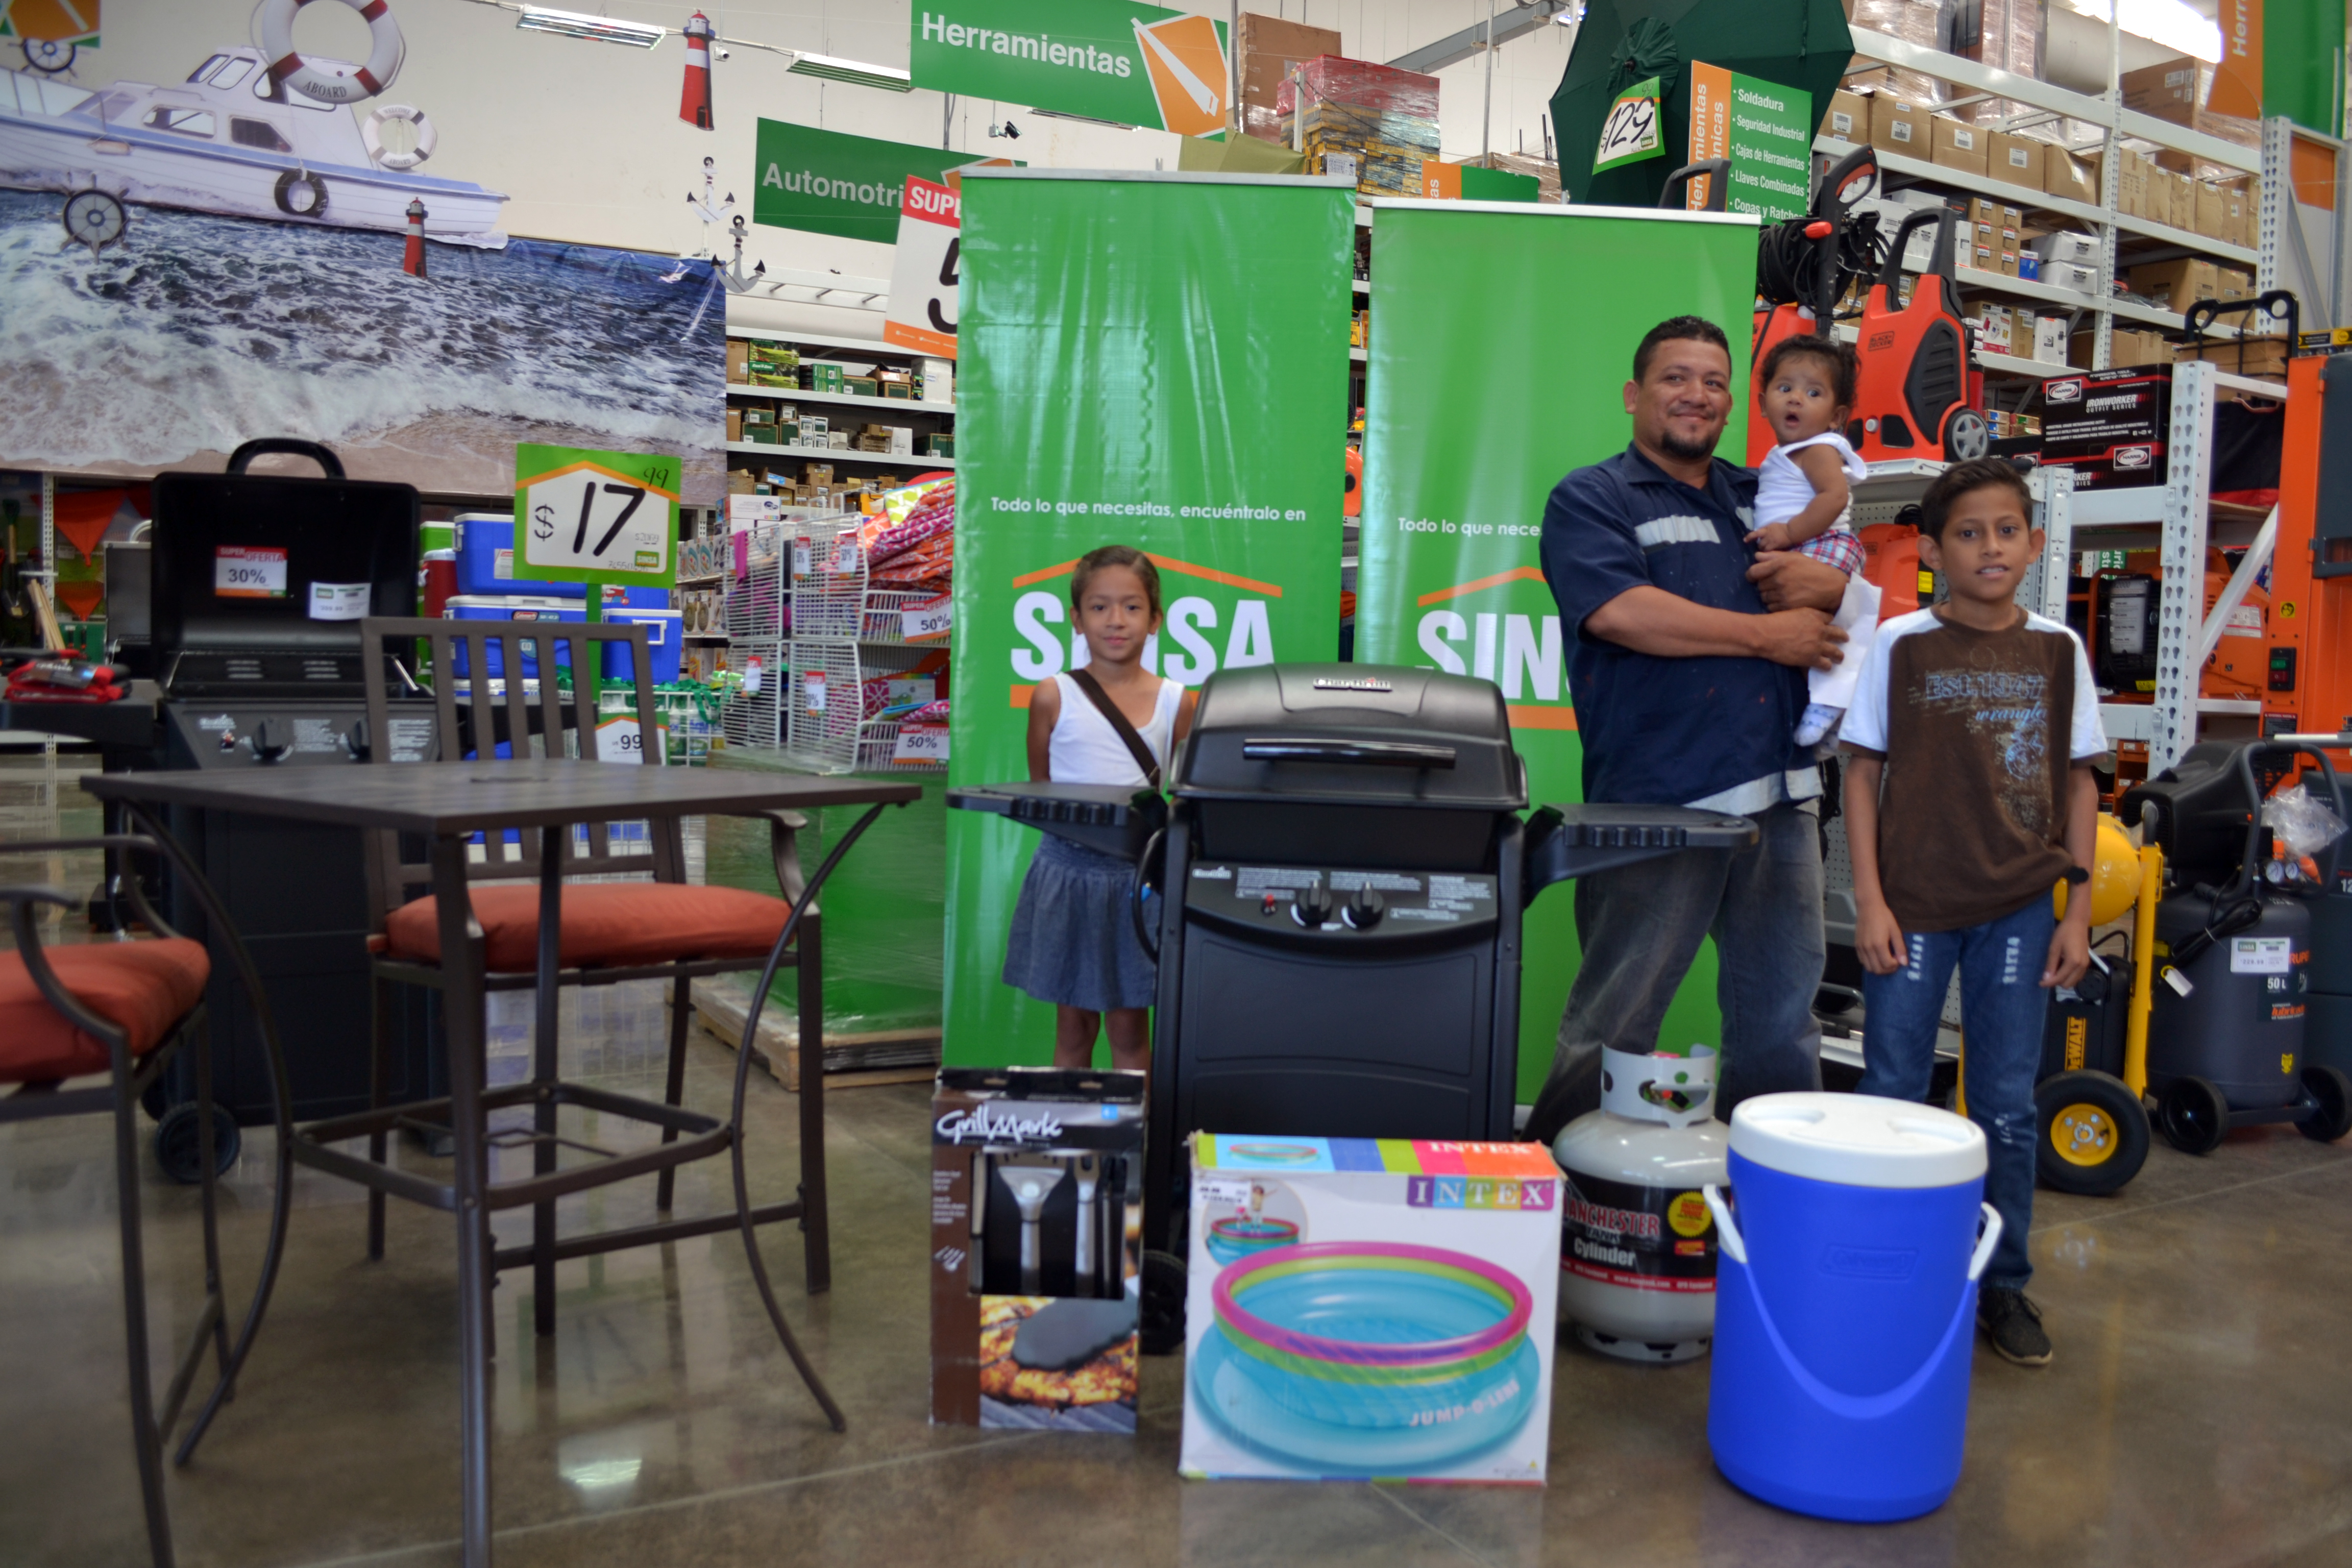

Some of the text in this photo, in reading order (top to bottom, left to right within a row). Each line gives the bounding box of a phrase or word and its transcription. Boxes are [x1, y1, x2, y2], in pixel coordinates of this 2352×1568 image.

[922, 12, 1131, 78] Herramientas
[303, 80, 347, 98] ABOARD
[1737, 88, 1784, 112] Soldadura
[1736, 114, 1805, 142] Seguridad Industrial
[1690, 83, 1707, 211] Hermientas
[1735, 143, 1805, 171] Cajas de Herramientas
[1735, 169, 1804, 197] Llaves Combinadas
[1734, 198, 1760, 214] Copas
[1762, 207, 1768, 218] y
[2086, 394, 2138, 408] IRONWORKER
[2112, 402, 2137, 411] SERIES
[643, 467, 669, 488] 99
[573, 481, 646, 557] 17
[990, 497, 1306, 521] Todo lo que necesitas, encuéntralo en
[1398, 517, 1542, 539] Todo lo que nece
[220, 547, 246, 555] SUPER
[246, 551, 285, 562] OFERTA
[228, 568, 267, 584] 30%
[920, 613, 951, 631] 50%
[1011, 591, 1275, 687] SSA
[1417, 610, 1571, 701] SIN
[906, 736, 938, 749] 50%
[2267, 977, 2286, 990] 50 L
[1429, 1141, 1536, 1155] INTEX
[1414, 1179, 1547, 1207] INTEX
[1574, 1237, 1636, 1267] Cylinder
